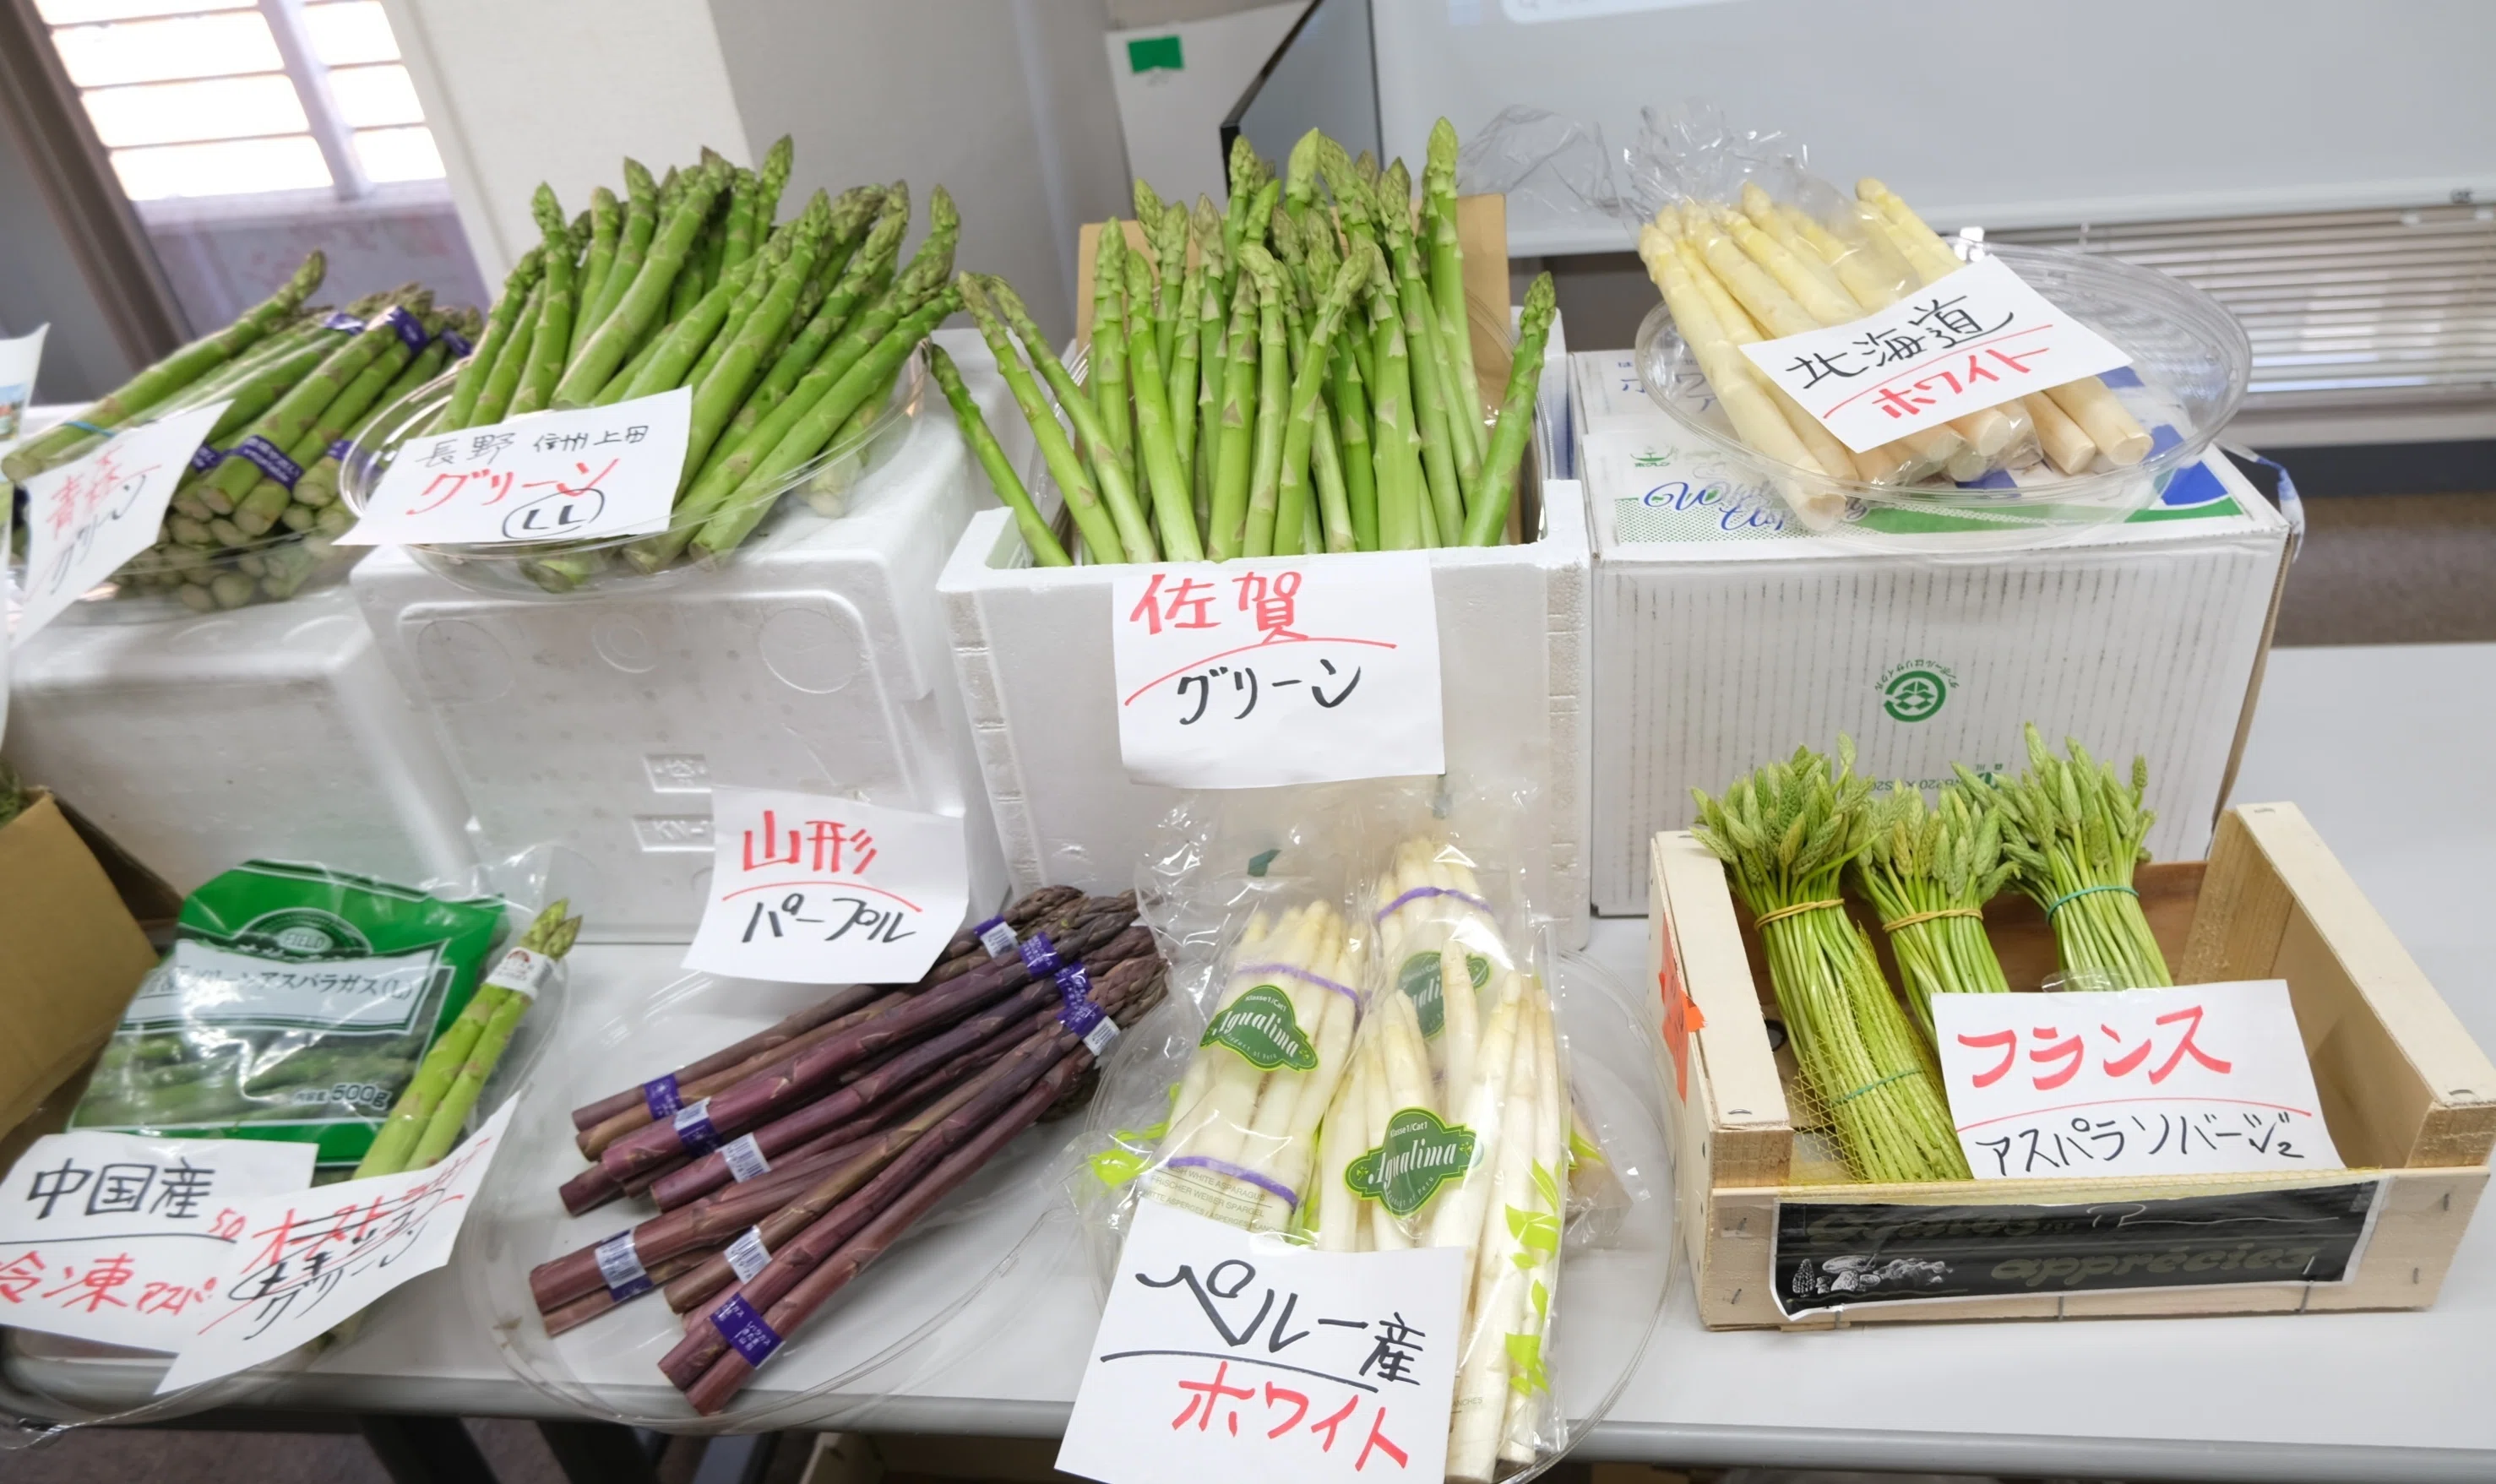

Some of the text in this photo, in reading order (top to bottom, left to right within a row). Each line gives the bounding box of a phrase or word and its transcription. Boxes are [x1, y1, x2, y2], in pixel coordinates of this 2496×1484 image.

[1786, 295, 2014, 389] 北海道
[1873, 347, 2049, 418] ホワイト
[416, 425, 649, 468] 長野 信州上田
[405, 459, 619, 514] グリーン
[523, 505, 589, 530] LL
[50, 474, 146, 595] グリーン
[1129, 571, 1308, 644] 佐賀
[1177, 659, 1361, 725] グリーン
[743, 810, 877, 874] 山形
[742, 893, 916, 943] パープル
[1957, 1005, 2232, 1090] フランス
[332, 1084, 390, 1108] 500g
[27, 1156, 215, 1220] 中国産
[1188, 1170, 1215, 1186] WHITE
[1215, 1179, 1266, 1201] ASPARAGUS
[1368, 1138, 1458, 1189] Agualima
[1226, 1201, 1264, 1217] SPARGEL
[1135, 1259, 1426, 1385] ペルー産
[1172, 1361, 1408, 1471] ホワイト
[1451, 1396, 1483, 1408] ANCHES
